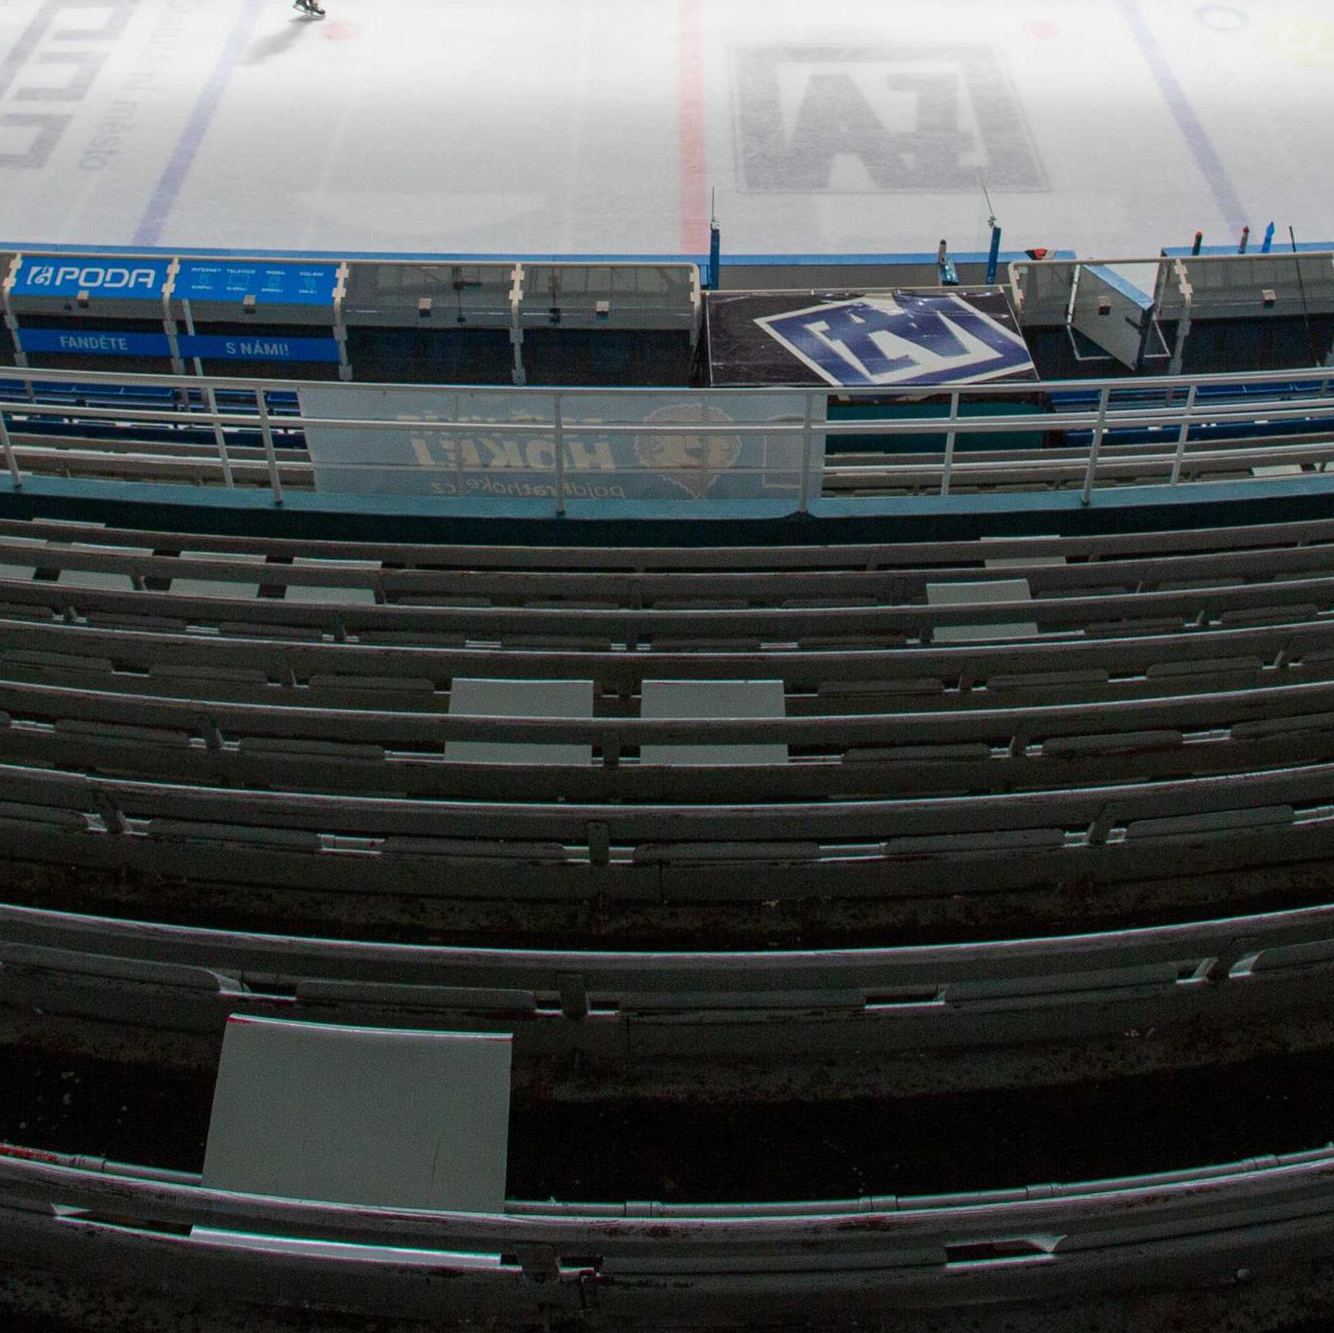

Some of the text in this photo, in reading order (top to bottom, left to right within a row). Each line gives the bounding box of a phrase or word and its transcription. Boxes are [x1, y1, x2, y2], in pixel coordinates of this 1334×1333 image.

[55, 268, 156, 289] PODA
[191, 266, 222, 274] INTERNET
[59, 334, 128, 351] FANDĚTE
[226, 338, 291, 357] S NÁMI!
